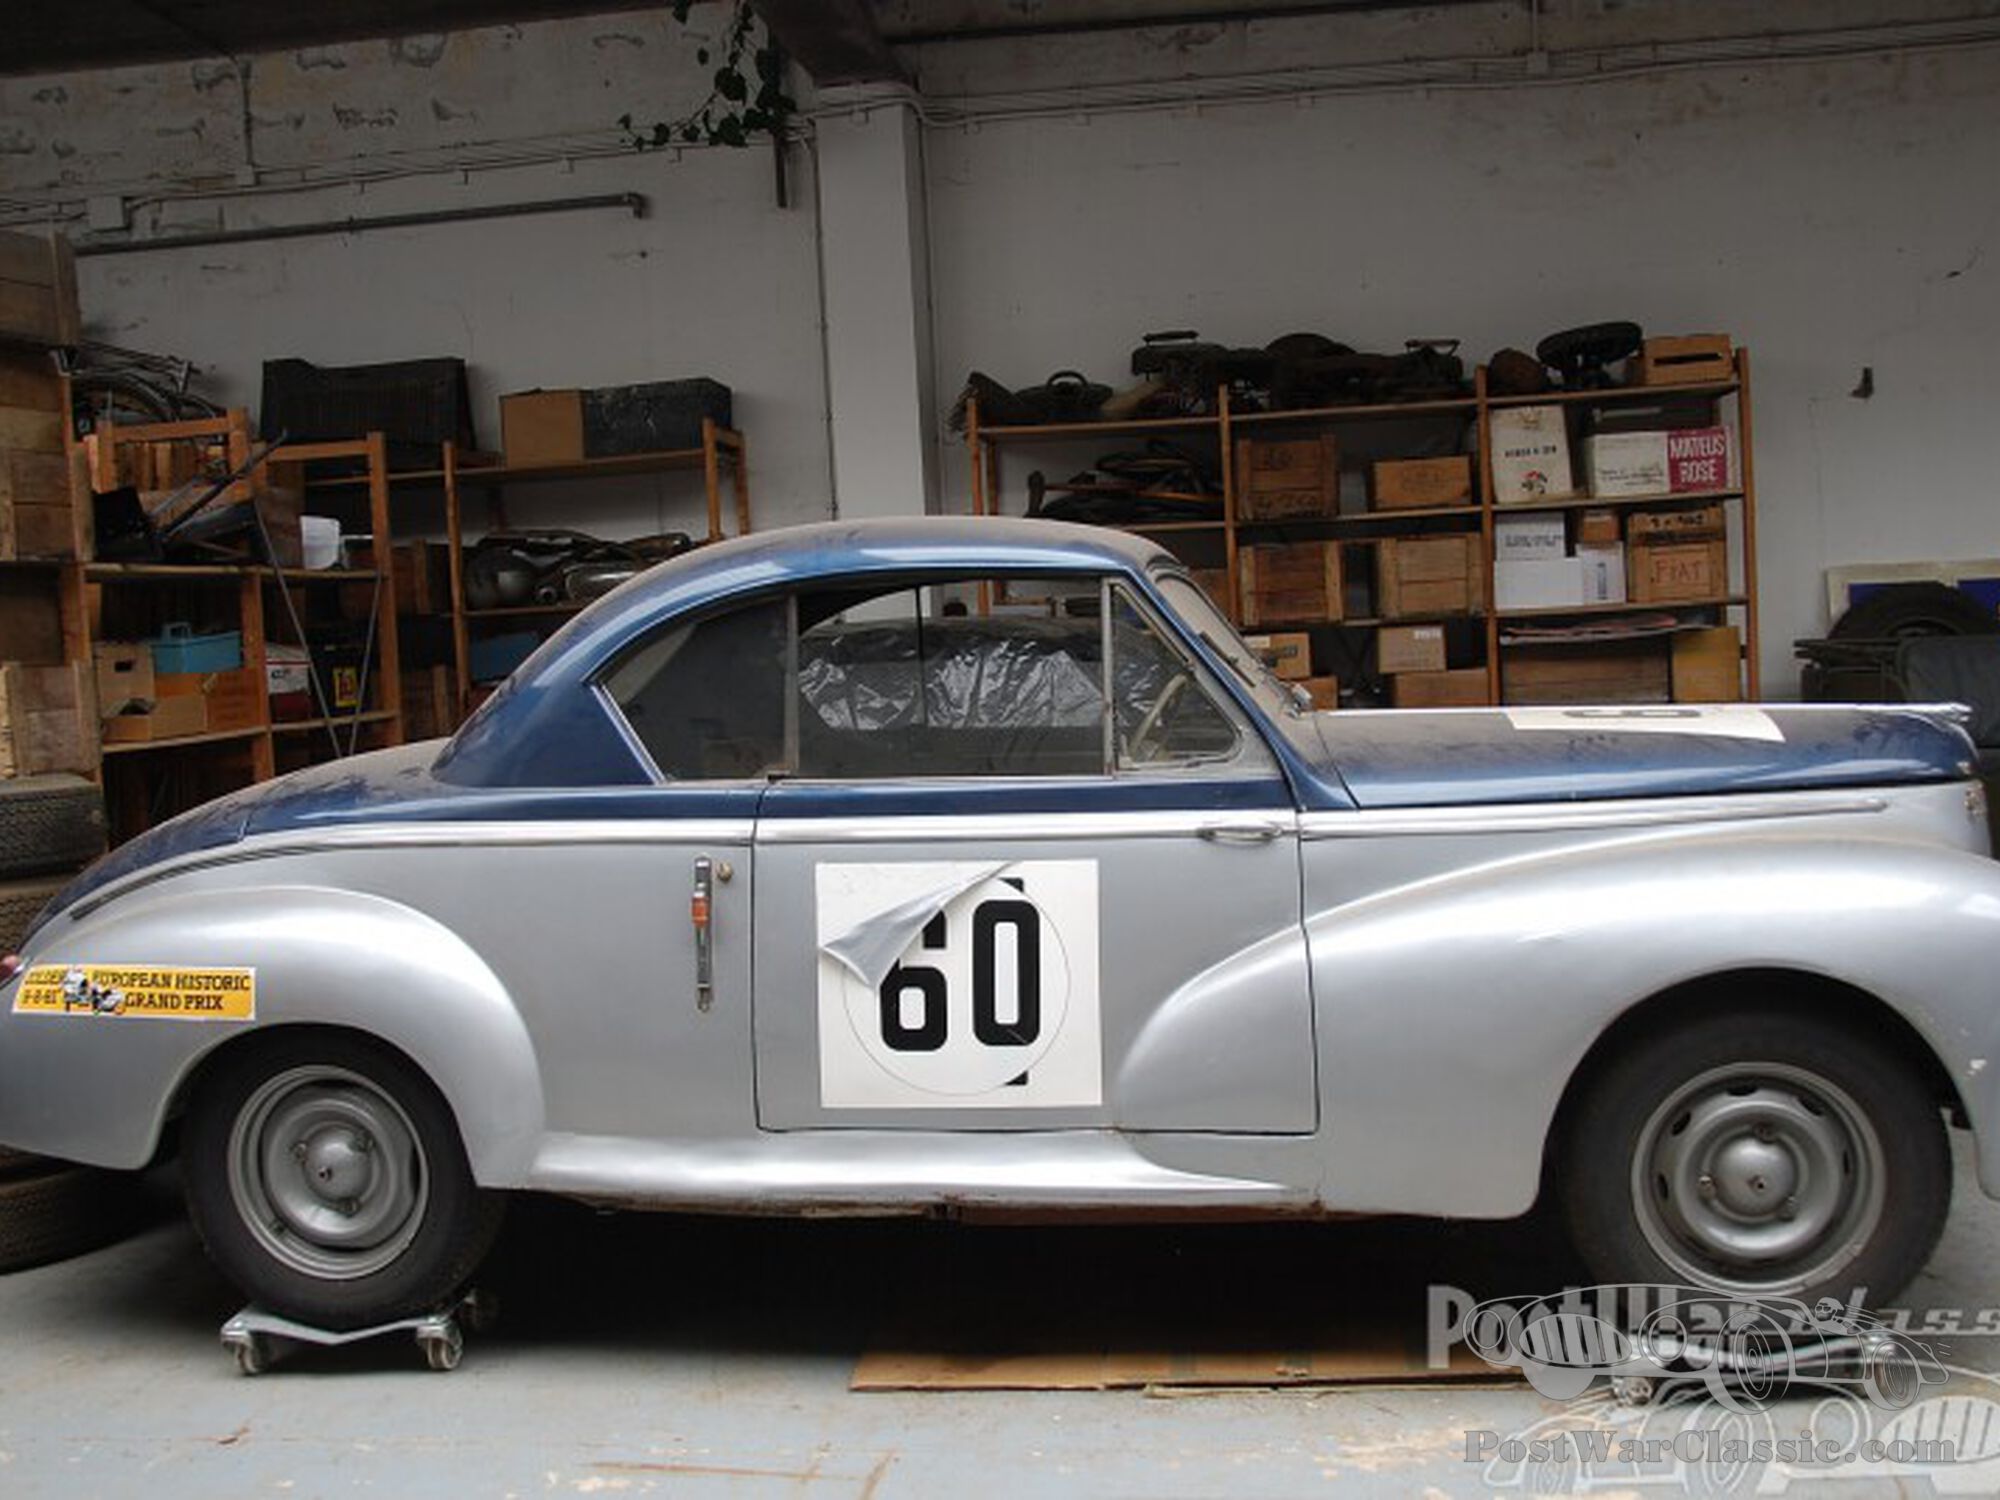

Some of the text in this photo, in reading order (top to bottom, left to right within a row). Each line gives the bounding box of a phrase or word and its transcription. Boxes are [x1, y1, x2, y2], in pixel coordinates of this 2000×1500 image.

[1669, 435, 1725, 459] MATEUS
[93, 971, 251, 991] EUROPEAN HISTORIC
[879, 899, 1041, 1052] 60
[124, 992, 224, 1011] GRAND PRIX
